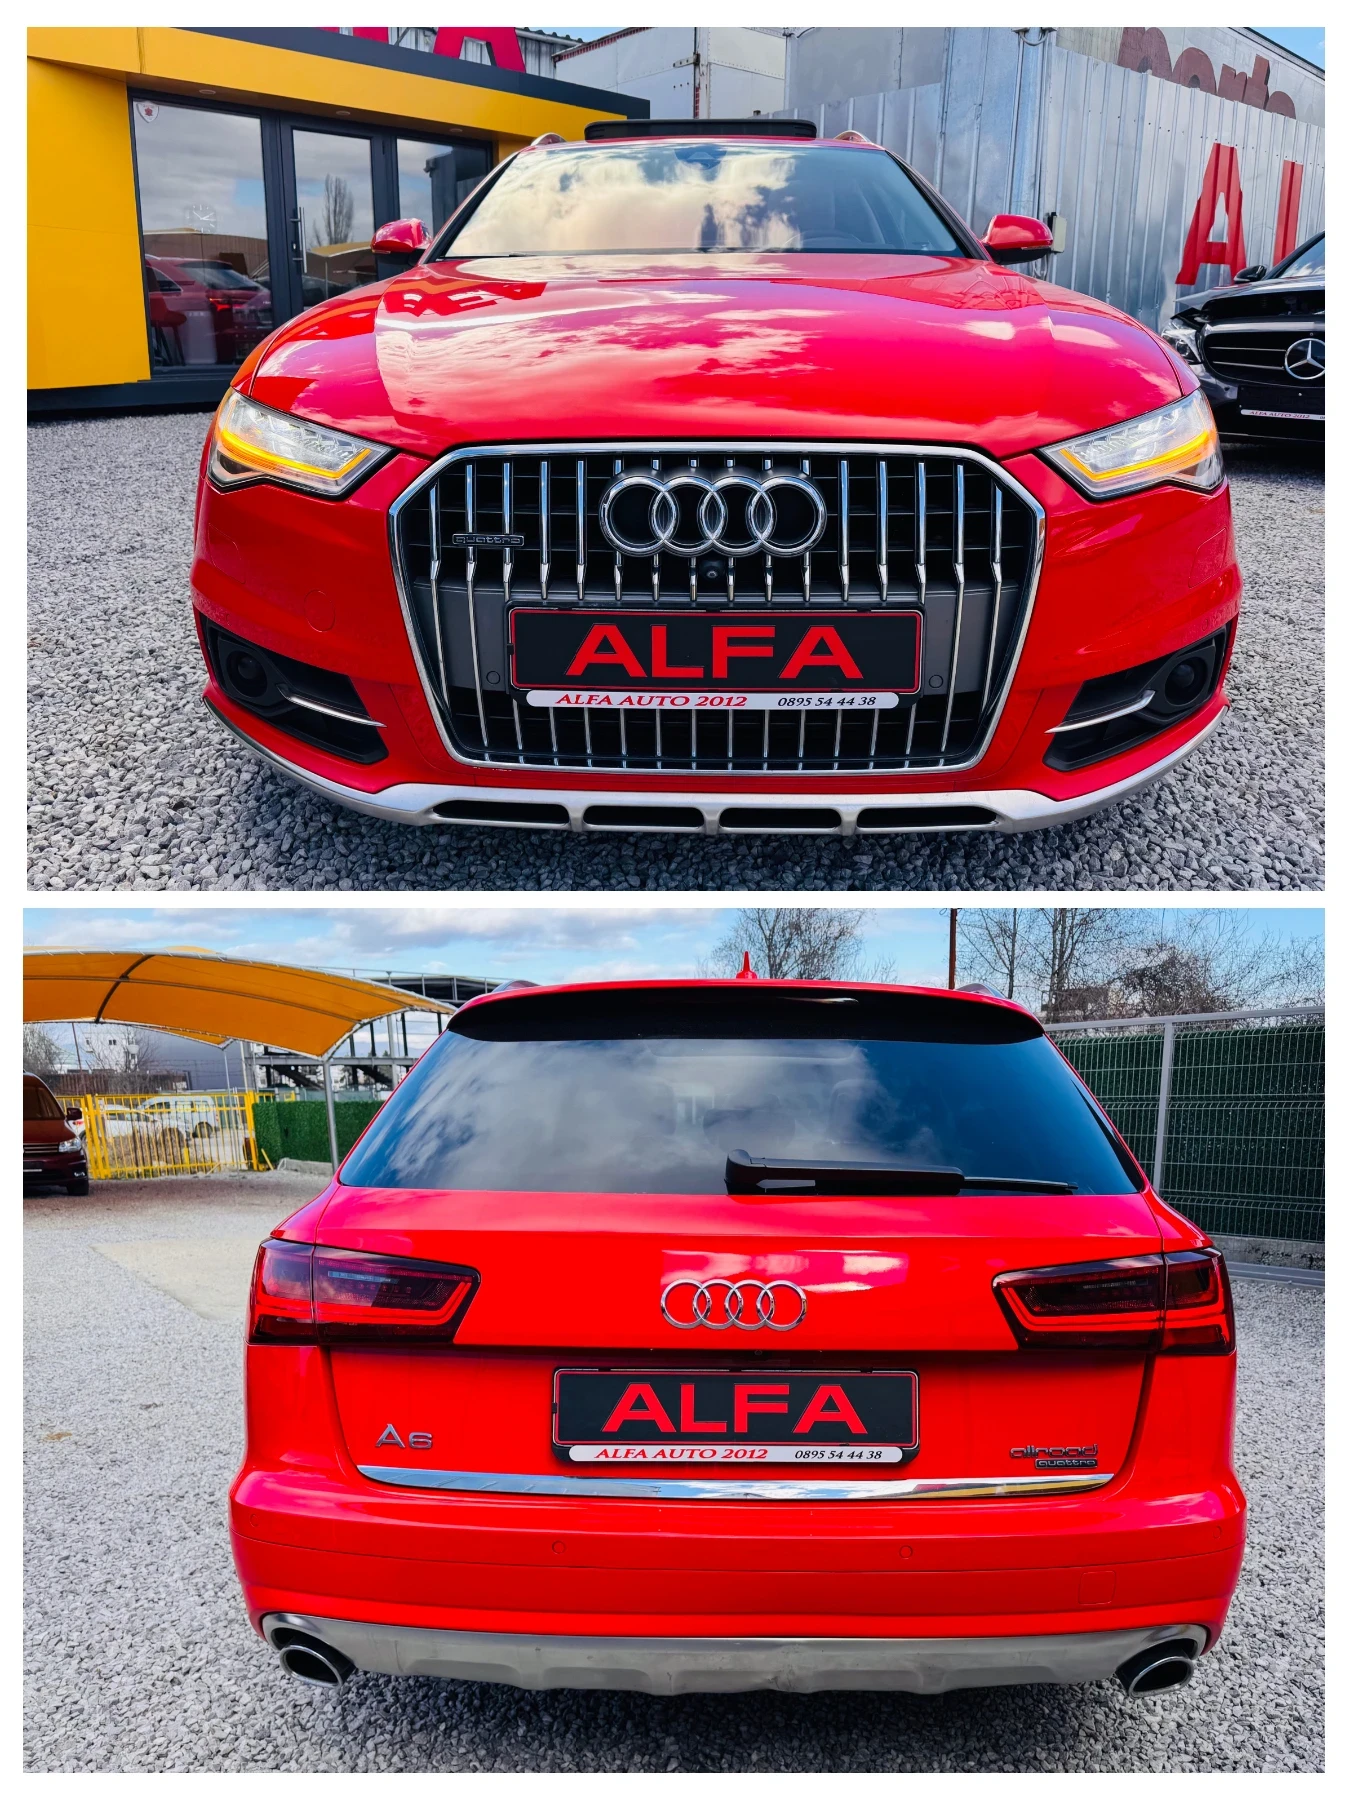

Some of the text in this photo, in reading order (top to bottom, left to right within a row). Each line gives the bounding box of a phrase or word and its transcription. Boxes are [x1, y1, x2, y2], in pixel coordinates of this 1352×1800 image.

[455, 536, 521, 544] quattro
[565, 623, 864, 679] ALFA
[555, 693, 877, 707] ALFA AUTO 2012 0895 54 44 38
[601, 1382, 869, 1434] ALFA
[375, 1423, 433, 1450] A6
[594, 1448, 882, 1460] ALFA AUTO 2012 0895 54 44 38
[1010, 1443, 1098, 1458] allroad
